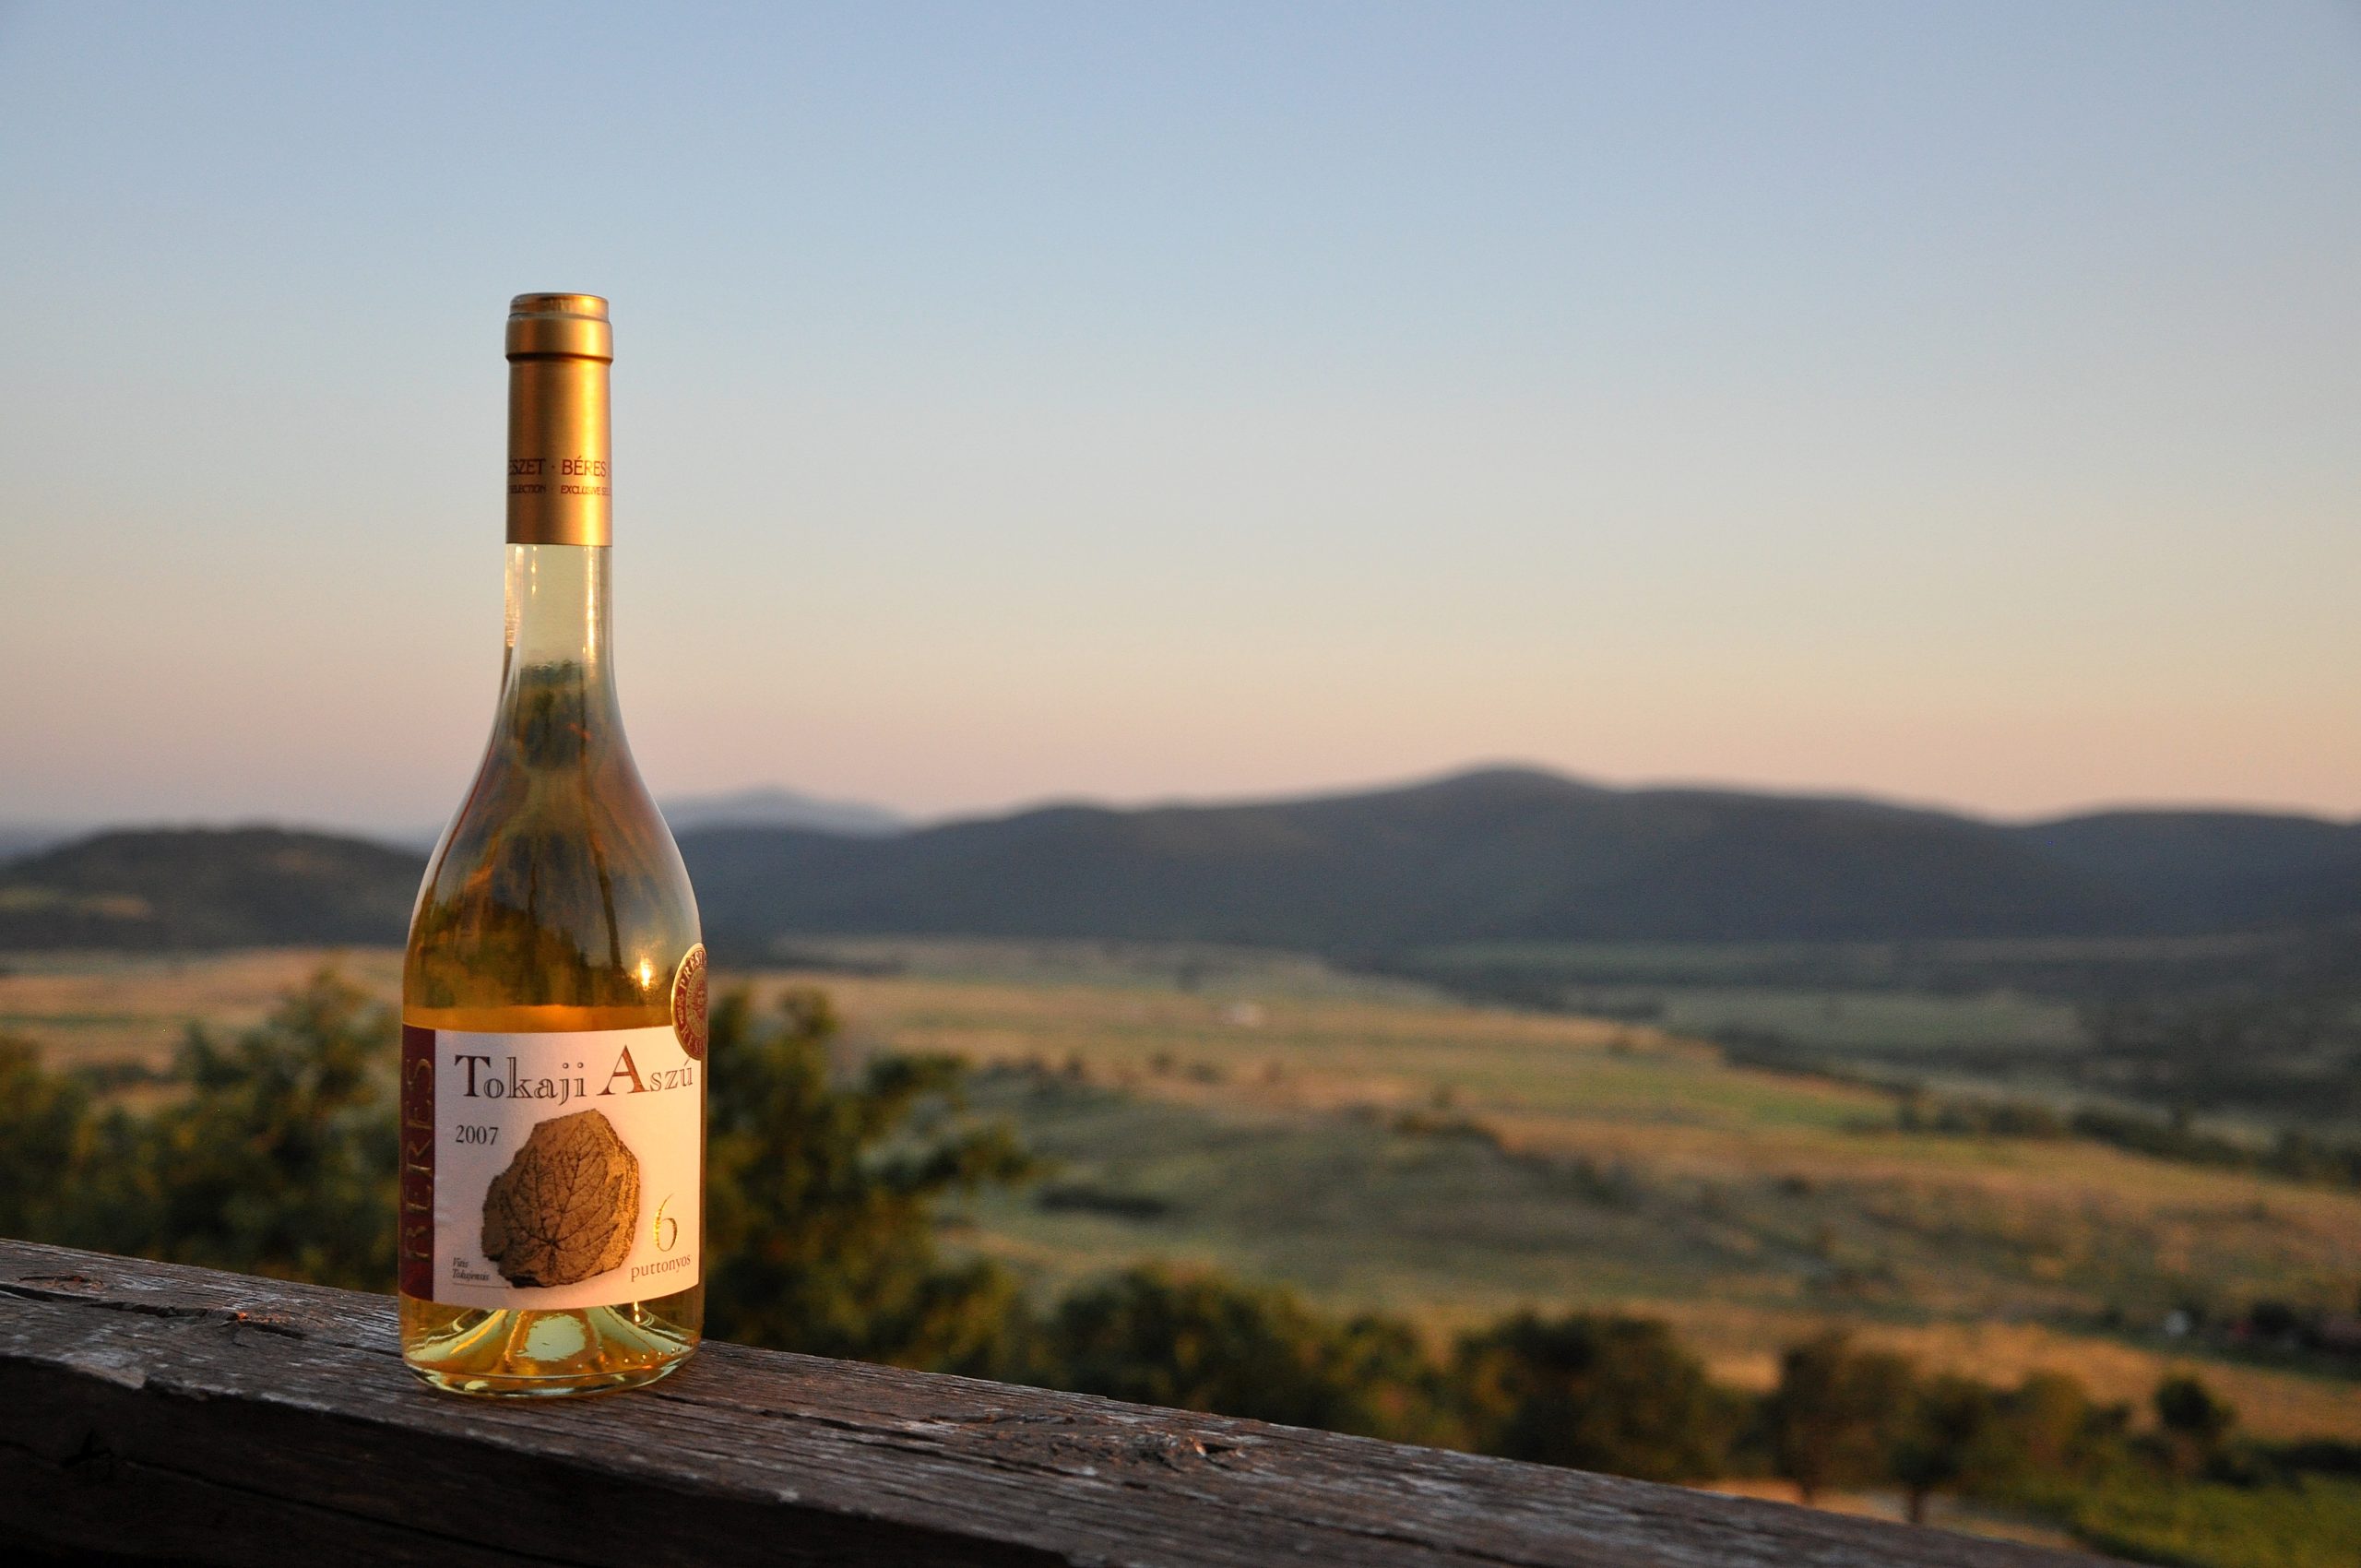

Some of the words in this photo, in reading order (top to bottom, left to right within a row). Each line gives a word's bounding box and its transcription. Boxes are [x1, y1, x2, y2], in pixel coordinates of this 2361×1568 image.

[562, 456, 607, 477] BÉRES
[561, 485, 601, 496] EXCLUSIVE
[454, 1054, 587, 1106] Tokaji
[597, 1044, 694, 1097] Aszú
[455, 1123, 500, 1146] 2007
[653, 1193, 678, 1253] 6
[630, 1253, 691, 1283] puttonyos
